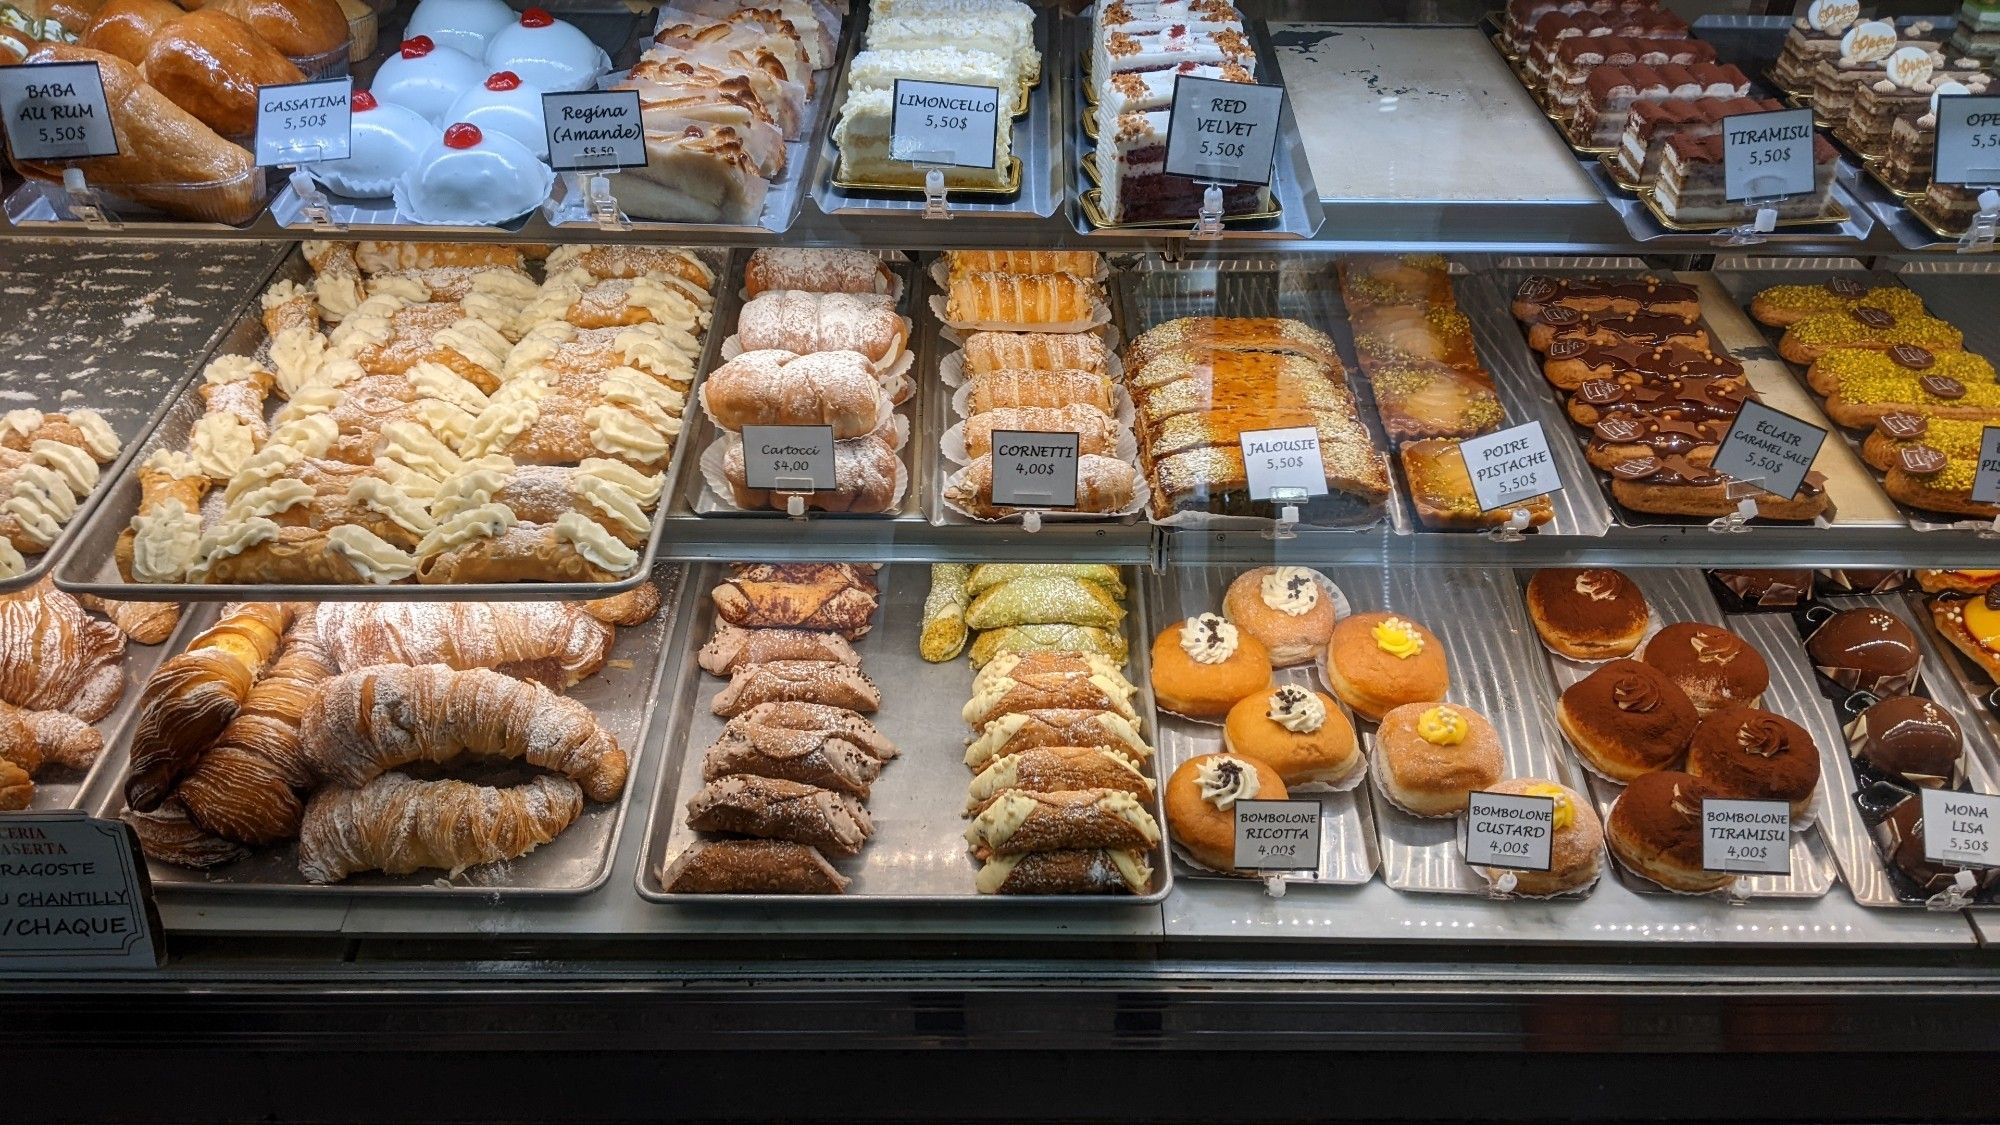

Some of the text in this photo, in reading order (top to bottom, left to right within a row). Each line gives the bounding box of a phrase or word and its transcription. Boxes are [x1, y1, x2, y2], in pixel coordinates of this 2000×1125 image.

[25, 83, 76, 98] BABA
[20, 104, 94, 120] AU RUM
[264, 95, 347, 113] CASSATINA
[900, 94, 995, 113] LIMONCELLO
[1211, 98, 1247, 114] RED
[283, 114, 327, 130] 5,50$
[562, 105, 627, 124] Regina
[924, 115, 968, 131] 5,50$
[39, 126, 86, 143] 5,50$
[553, 123, 641, 143] (Amande)
[1197, 117, 1257, 137] VELVET
[1730, 125, 1810, 146] TIRAMISU
[1199, 141, 1245, 158] 5,50$
[1971, 134, 2000, 149] 5,5
[1749, 148, 1791, 165] 5,50$
[1756, 420, 1802, 447] ÉCLAIR
[762, 444, 820, 456] Cartocci
[999, 444, 1073, 458] CORNETTI
[1247, 439, 1315, 457] JALOUSIE
[1483, 437, 1529, 461] POIRE
[1734, 430, 1781, 456] CARAMEL
[773, 460, 809, 472] $4,00
[1016, 462, 1055, 476] 4,00$
[1267, 456, 1304, 470] 5,50$
[1475, 451, 1547, 482] PISTACHE
[1745, 452, 1783, 474] 5,50$
[1499, 472, 1537, 493] 5,50$
[1240, 813, 1318, 823] BOMBOLONE
[1472, 805, 1553, 822] BOMBOLONE
[1706, 811, 1789, 825] BOMBOLONE
[1944, 802, 1990, 819] MONA
[1245, 828, 1310, 840] RICOTTA
[1476, 821, 1546, 838] CUSTARD
[1710, 827, 1786, 842] TIRAMISU
[1952, 821, 1985, 835] LISA
[1489, 840, 1530, 856] 4,00$
[1727, 845, 1768, 859] 4,00$
[1950, 838, 1990, 853] 5,50$
[17, 890, 129, 907] CHANTILLY
